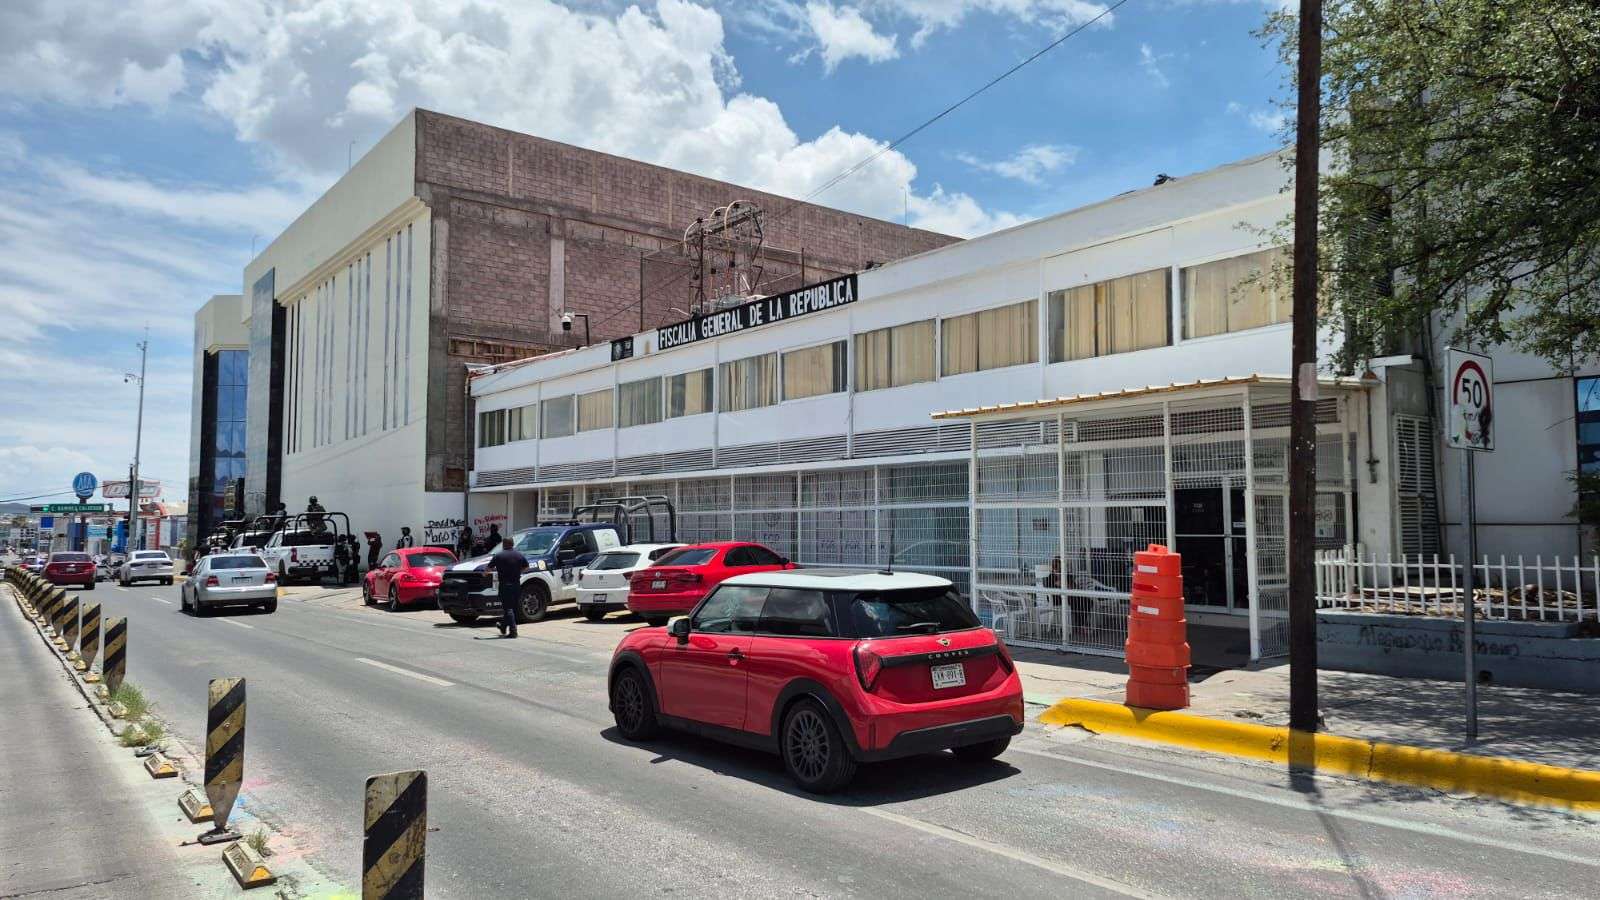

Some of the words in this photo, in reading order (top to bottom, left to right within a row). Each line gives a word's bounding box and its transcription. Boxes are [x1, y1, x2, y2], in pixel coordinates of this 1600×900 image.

[659, 320, 697, 349] FISCALIA
[702, 309, 744, 338] GENERAL
[749, 302, 764, 327] DE
[769, 298, 783, 321] LA
[790, 278, 853, 316] REPUBLICA
[1462, 377, 1482, 409] 50
[928, 650, 969, 659] COOPER
